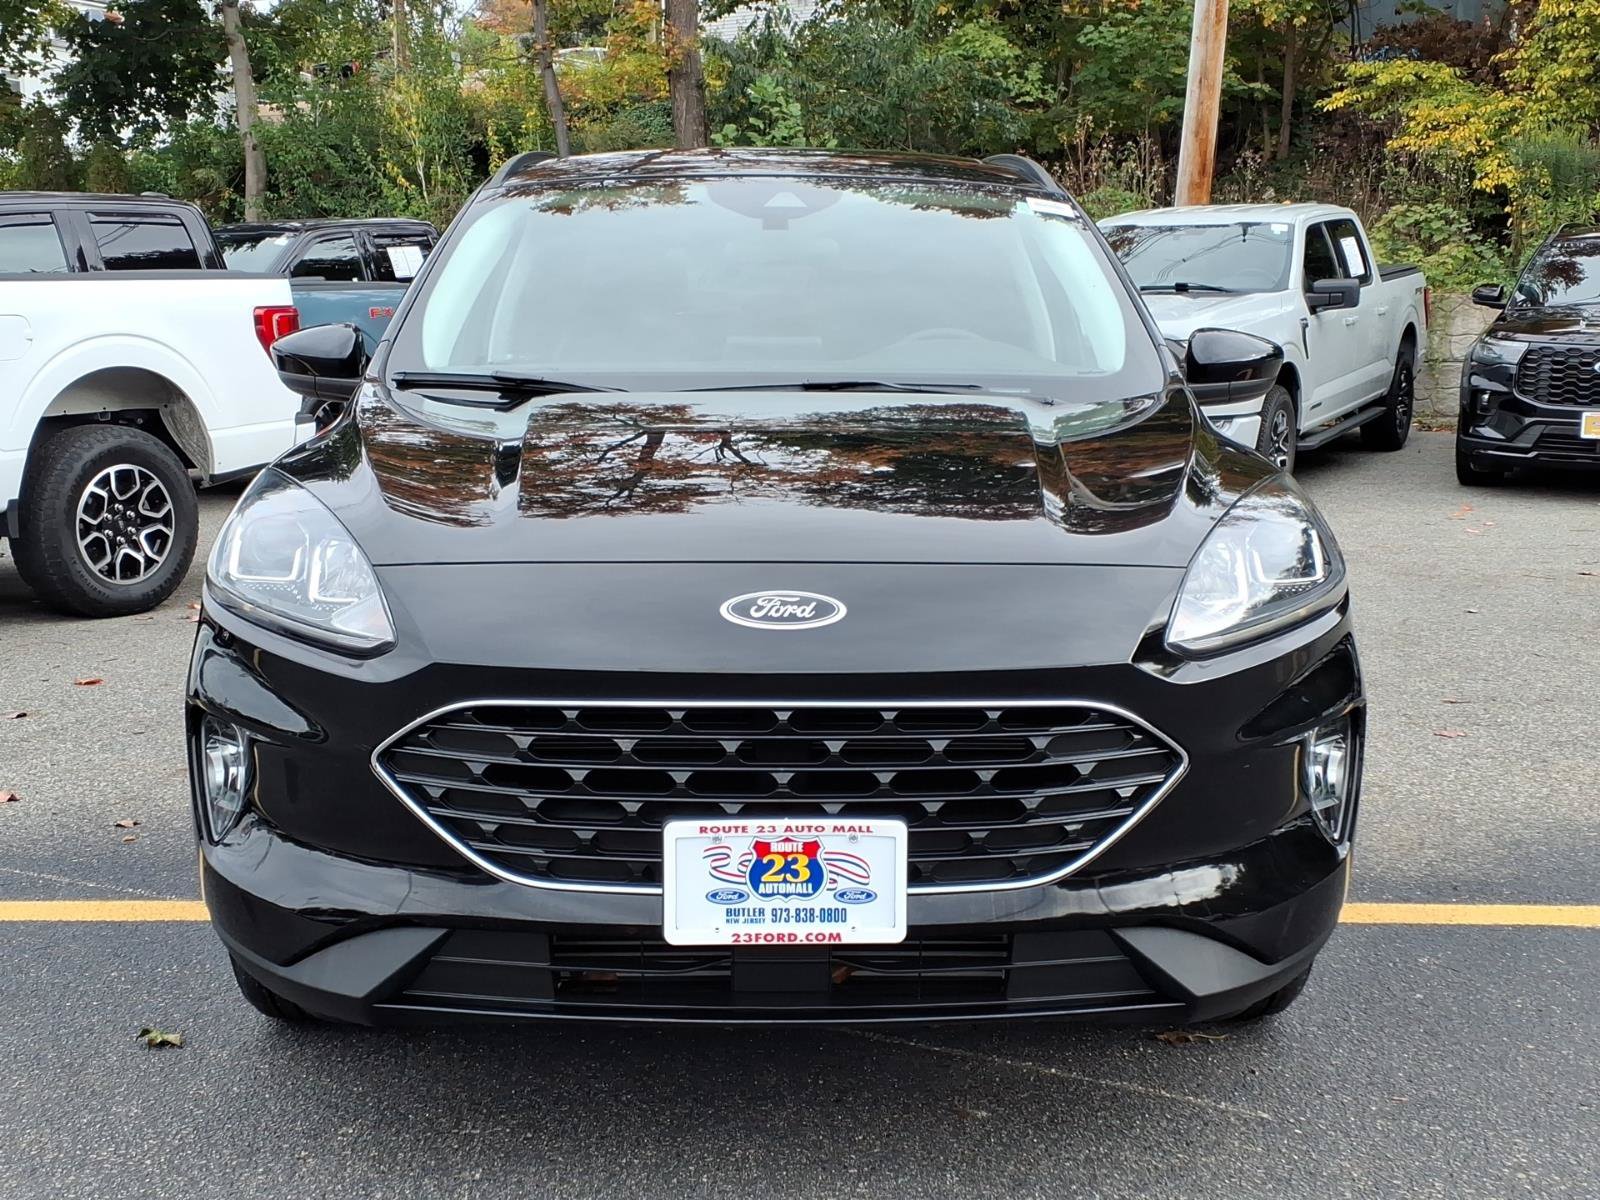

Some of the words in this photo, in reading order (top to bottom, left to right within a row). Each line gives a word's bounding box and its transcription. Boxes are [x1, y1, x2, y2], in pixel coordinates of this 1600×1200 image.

[749, 596, 817, 618] Ford
[699, 825, 749, 834] ROUTE
[756, 825, 777, 833] 23
[783, 825, 826, 833] AUTO
[832, 825, 874, 833] MALL
[770, 841, 804, 853] ROUTE
[760, 853, 811, 883] 23
[758, 882, 814, 895] AUTOMALL
[715, 890, 740, 900] Ford
[843, 890, 868, 900] Ford
[725, 907, 766, 917] BUTLER
[771, 907, 848, 924] 973-838-0800
[731, 932, 842, 943] 23FORD.COM
